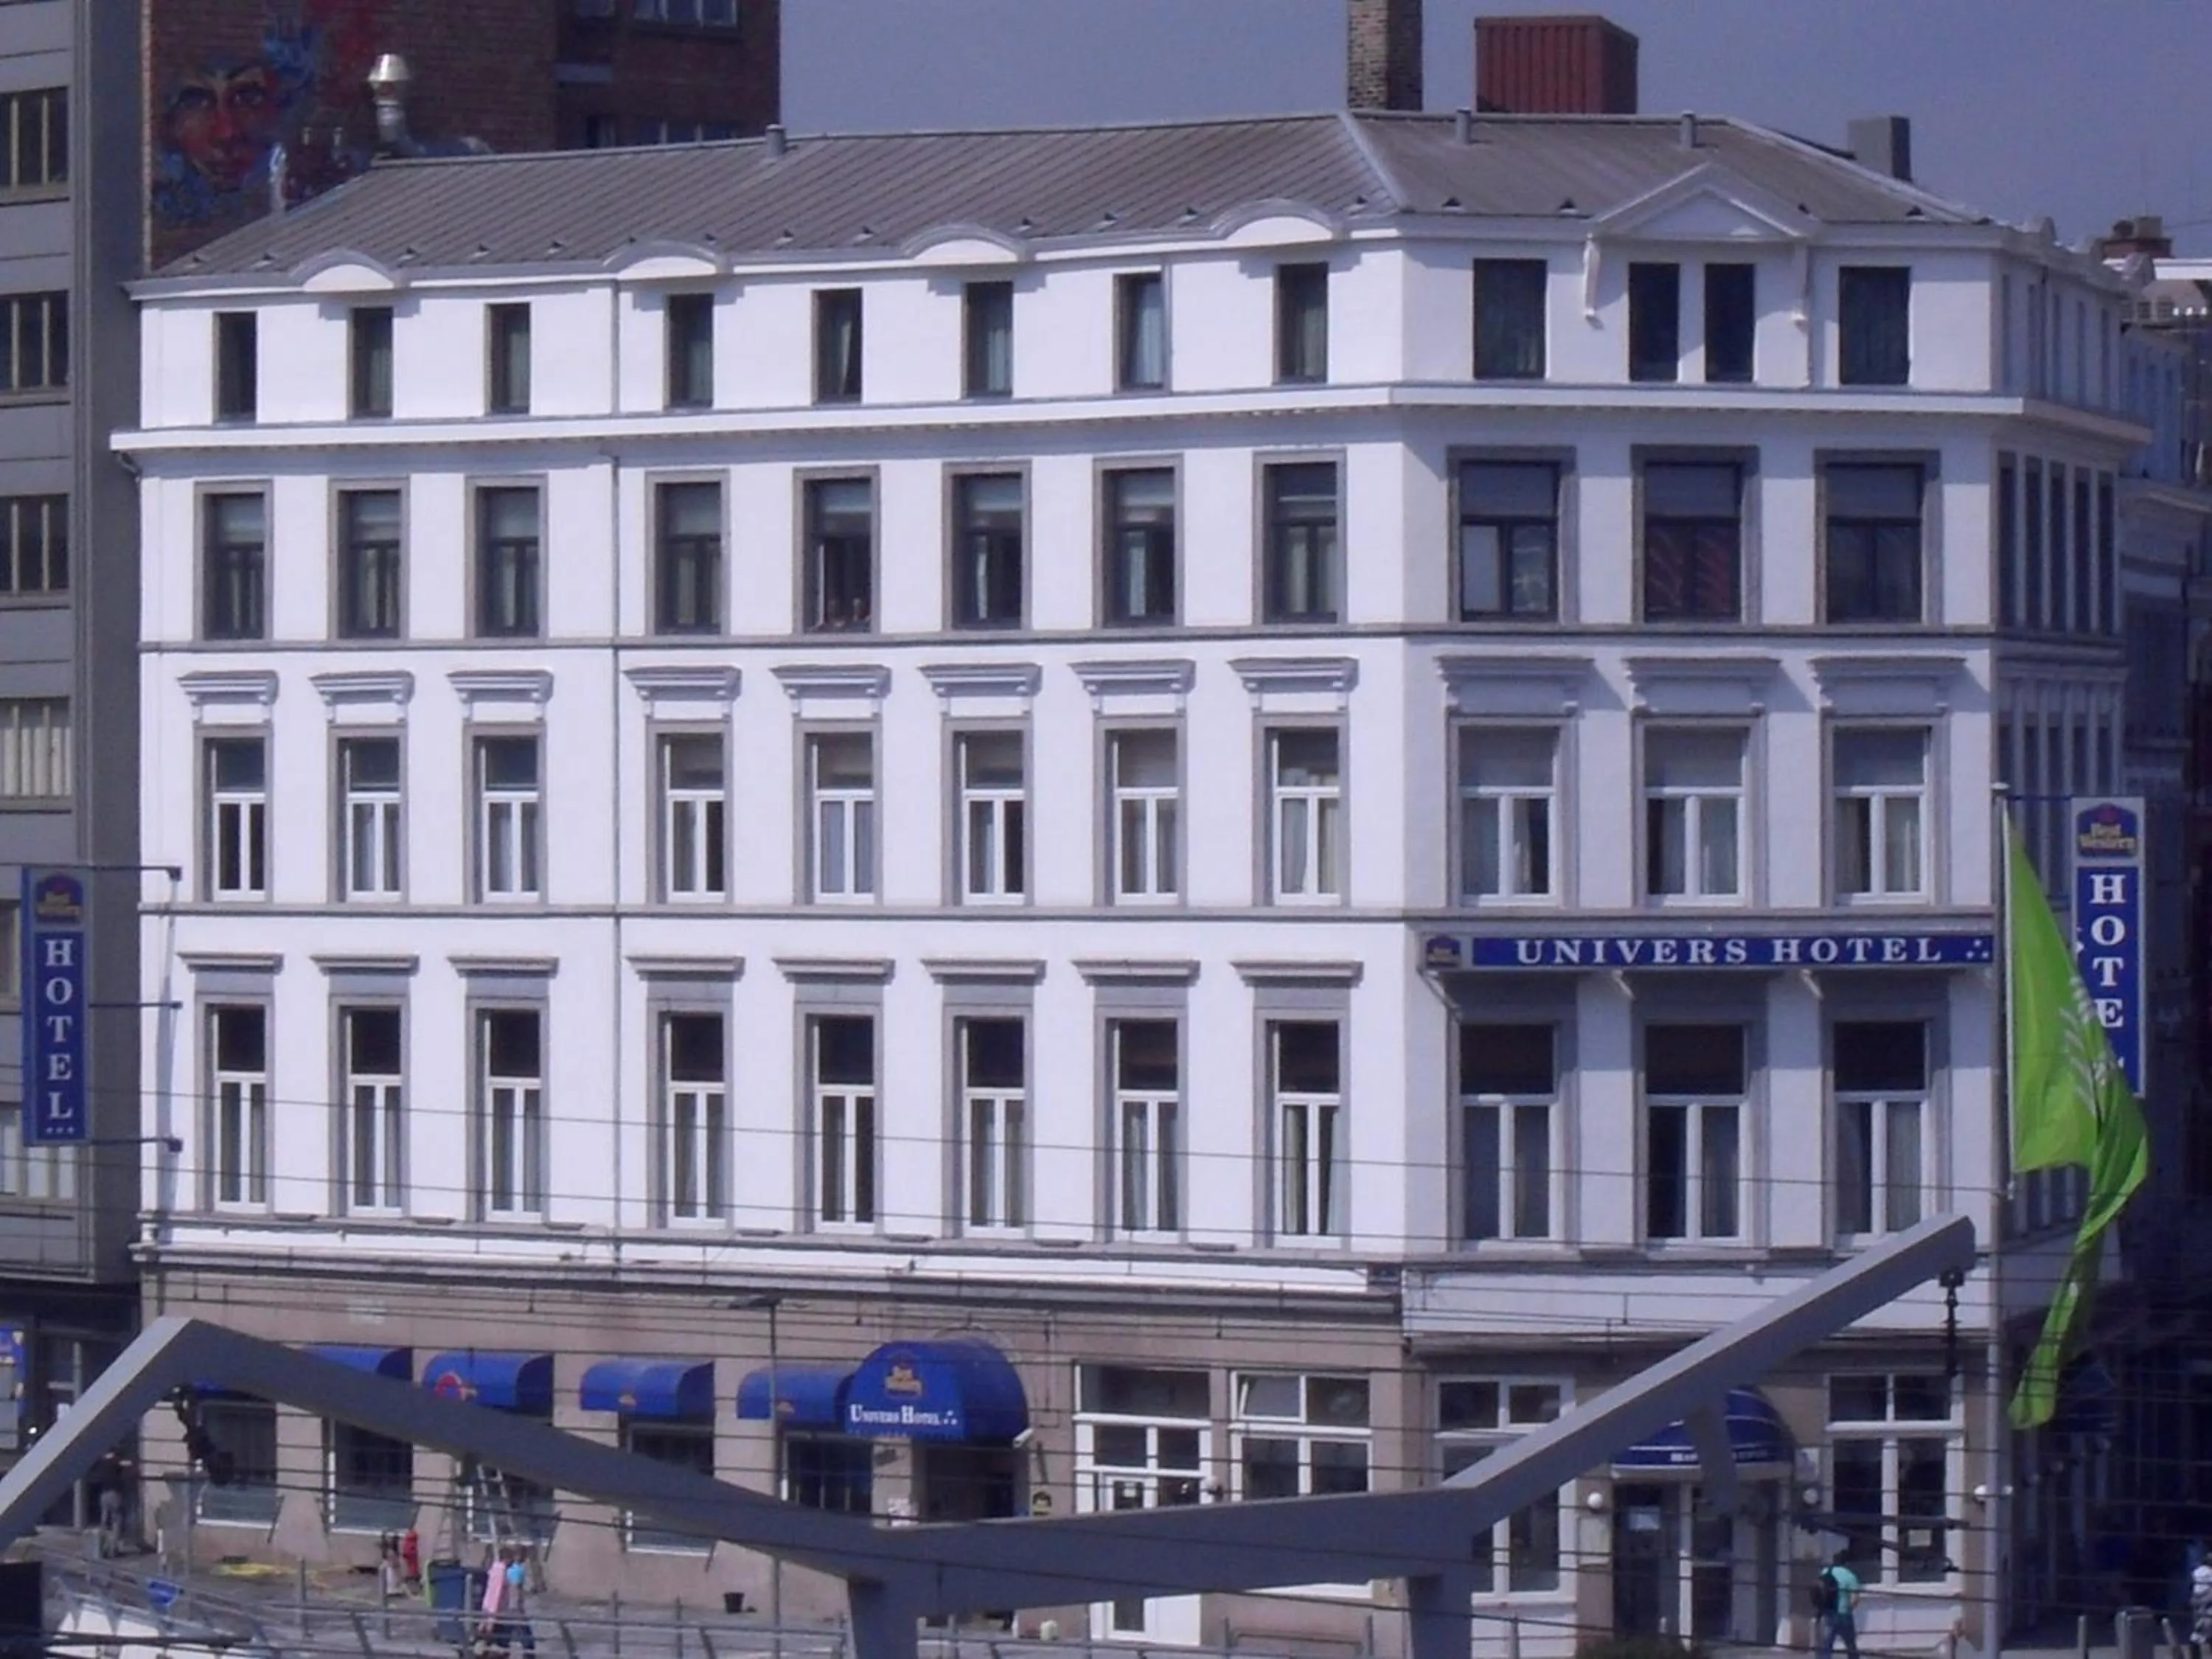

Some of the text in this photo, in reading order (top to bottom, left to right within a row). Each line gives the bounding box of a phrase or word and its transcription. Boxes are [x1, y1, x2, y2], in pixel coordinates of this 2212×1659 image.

[44, 938, 74, 1120] HOTEL
[1515, 937, 1942, 964] UNIVERS HOTEL
[2088, 873, 2127, 1068] HOTE
